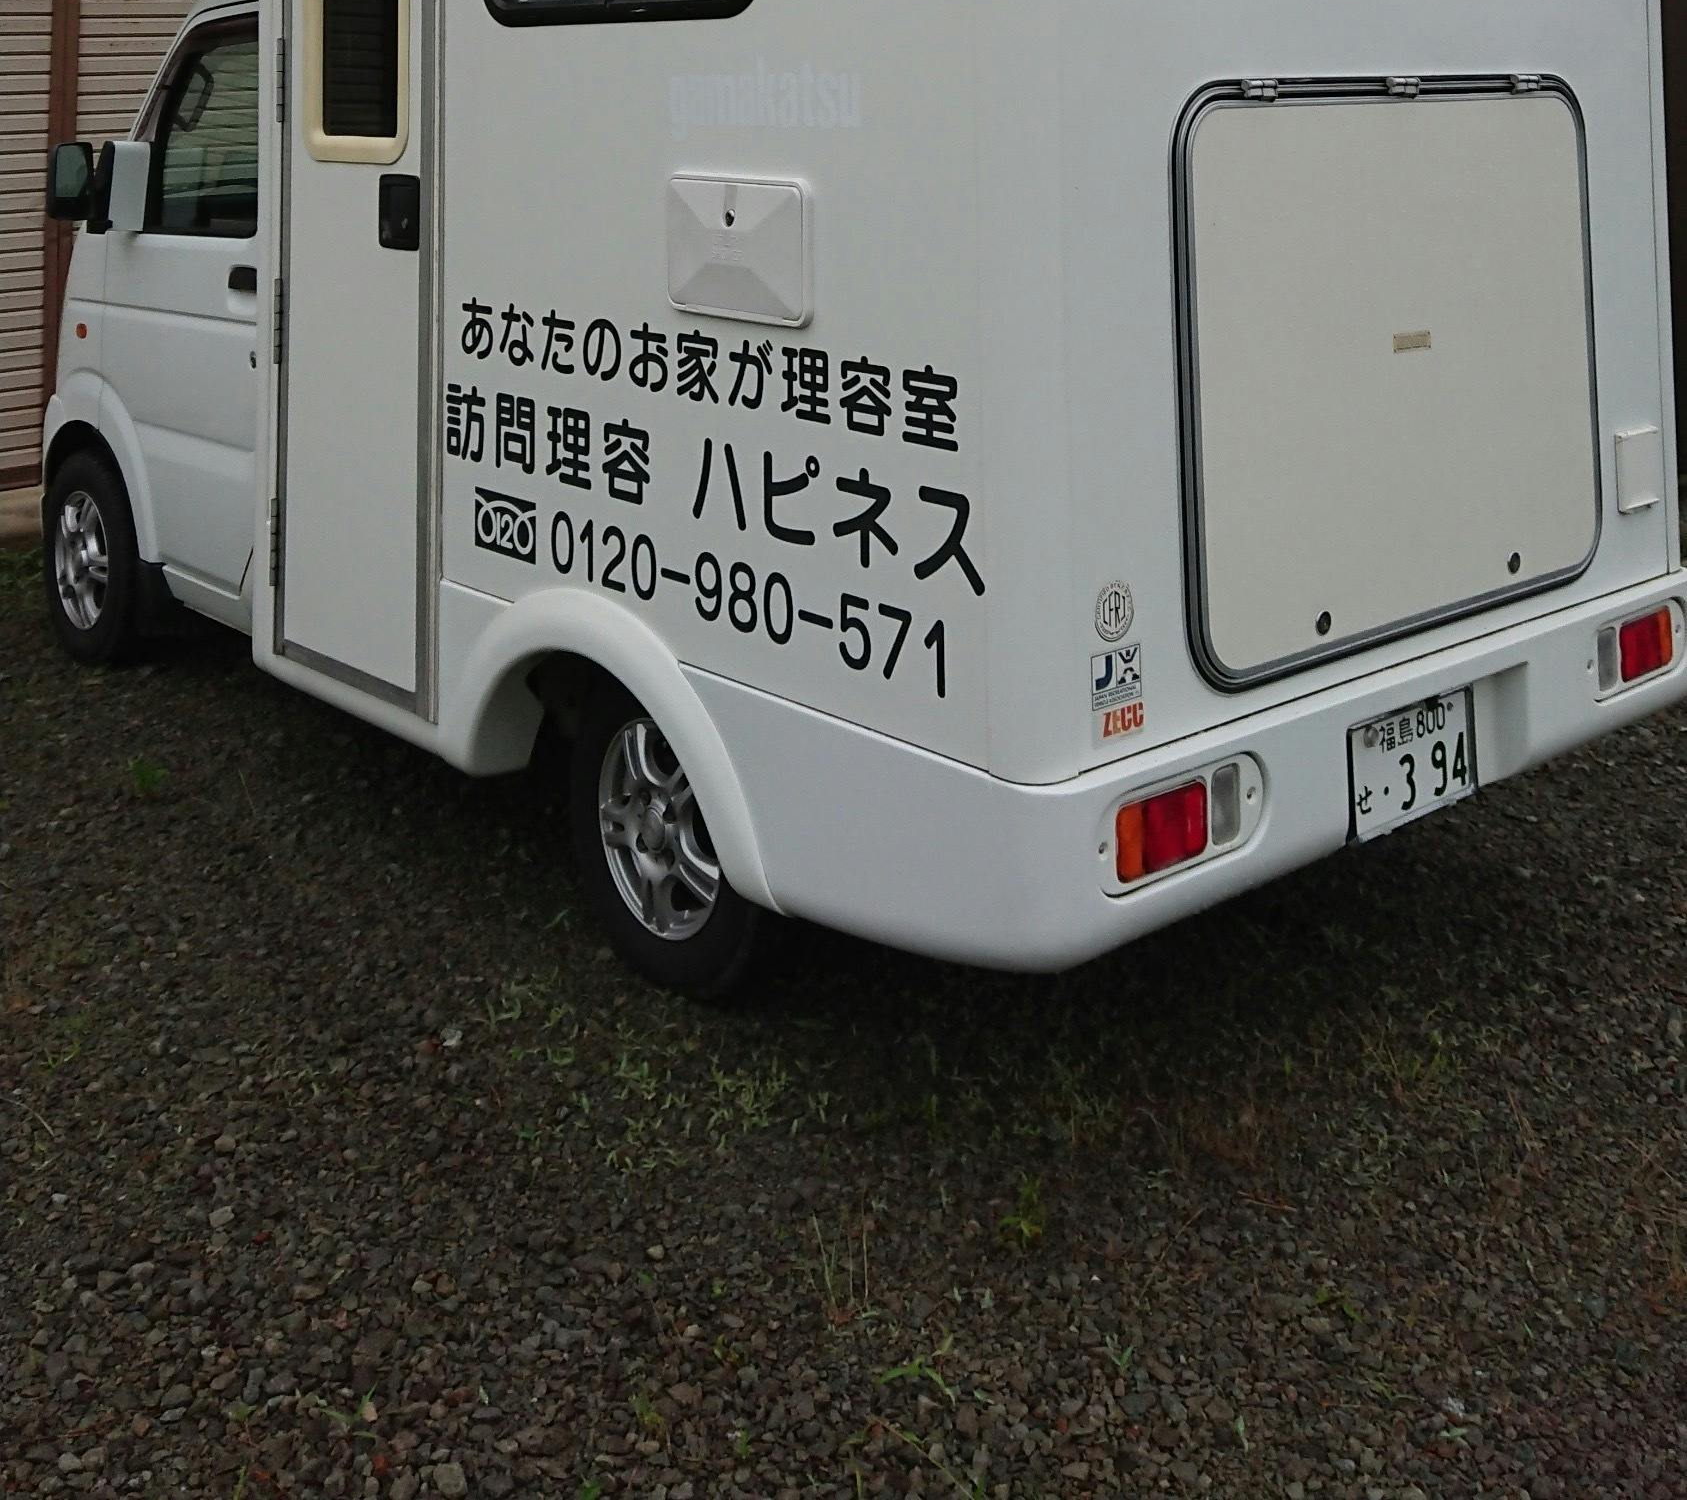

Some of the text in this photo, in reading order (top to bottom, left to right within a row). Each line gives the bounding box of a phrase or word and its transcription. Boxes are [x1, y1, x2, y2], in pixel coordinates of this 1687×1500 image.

[461, 296, 959, 452] あなたのお家が理容室
[446, 382, 986, 597] 訪問理容 ハピネス
[550, 509, 947, 699] 0120-980-571
[1102, 701, 1144, 738] ZECC
